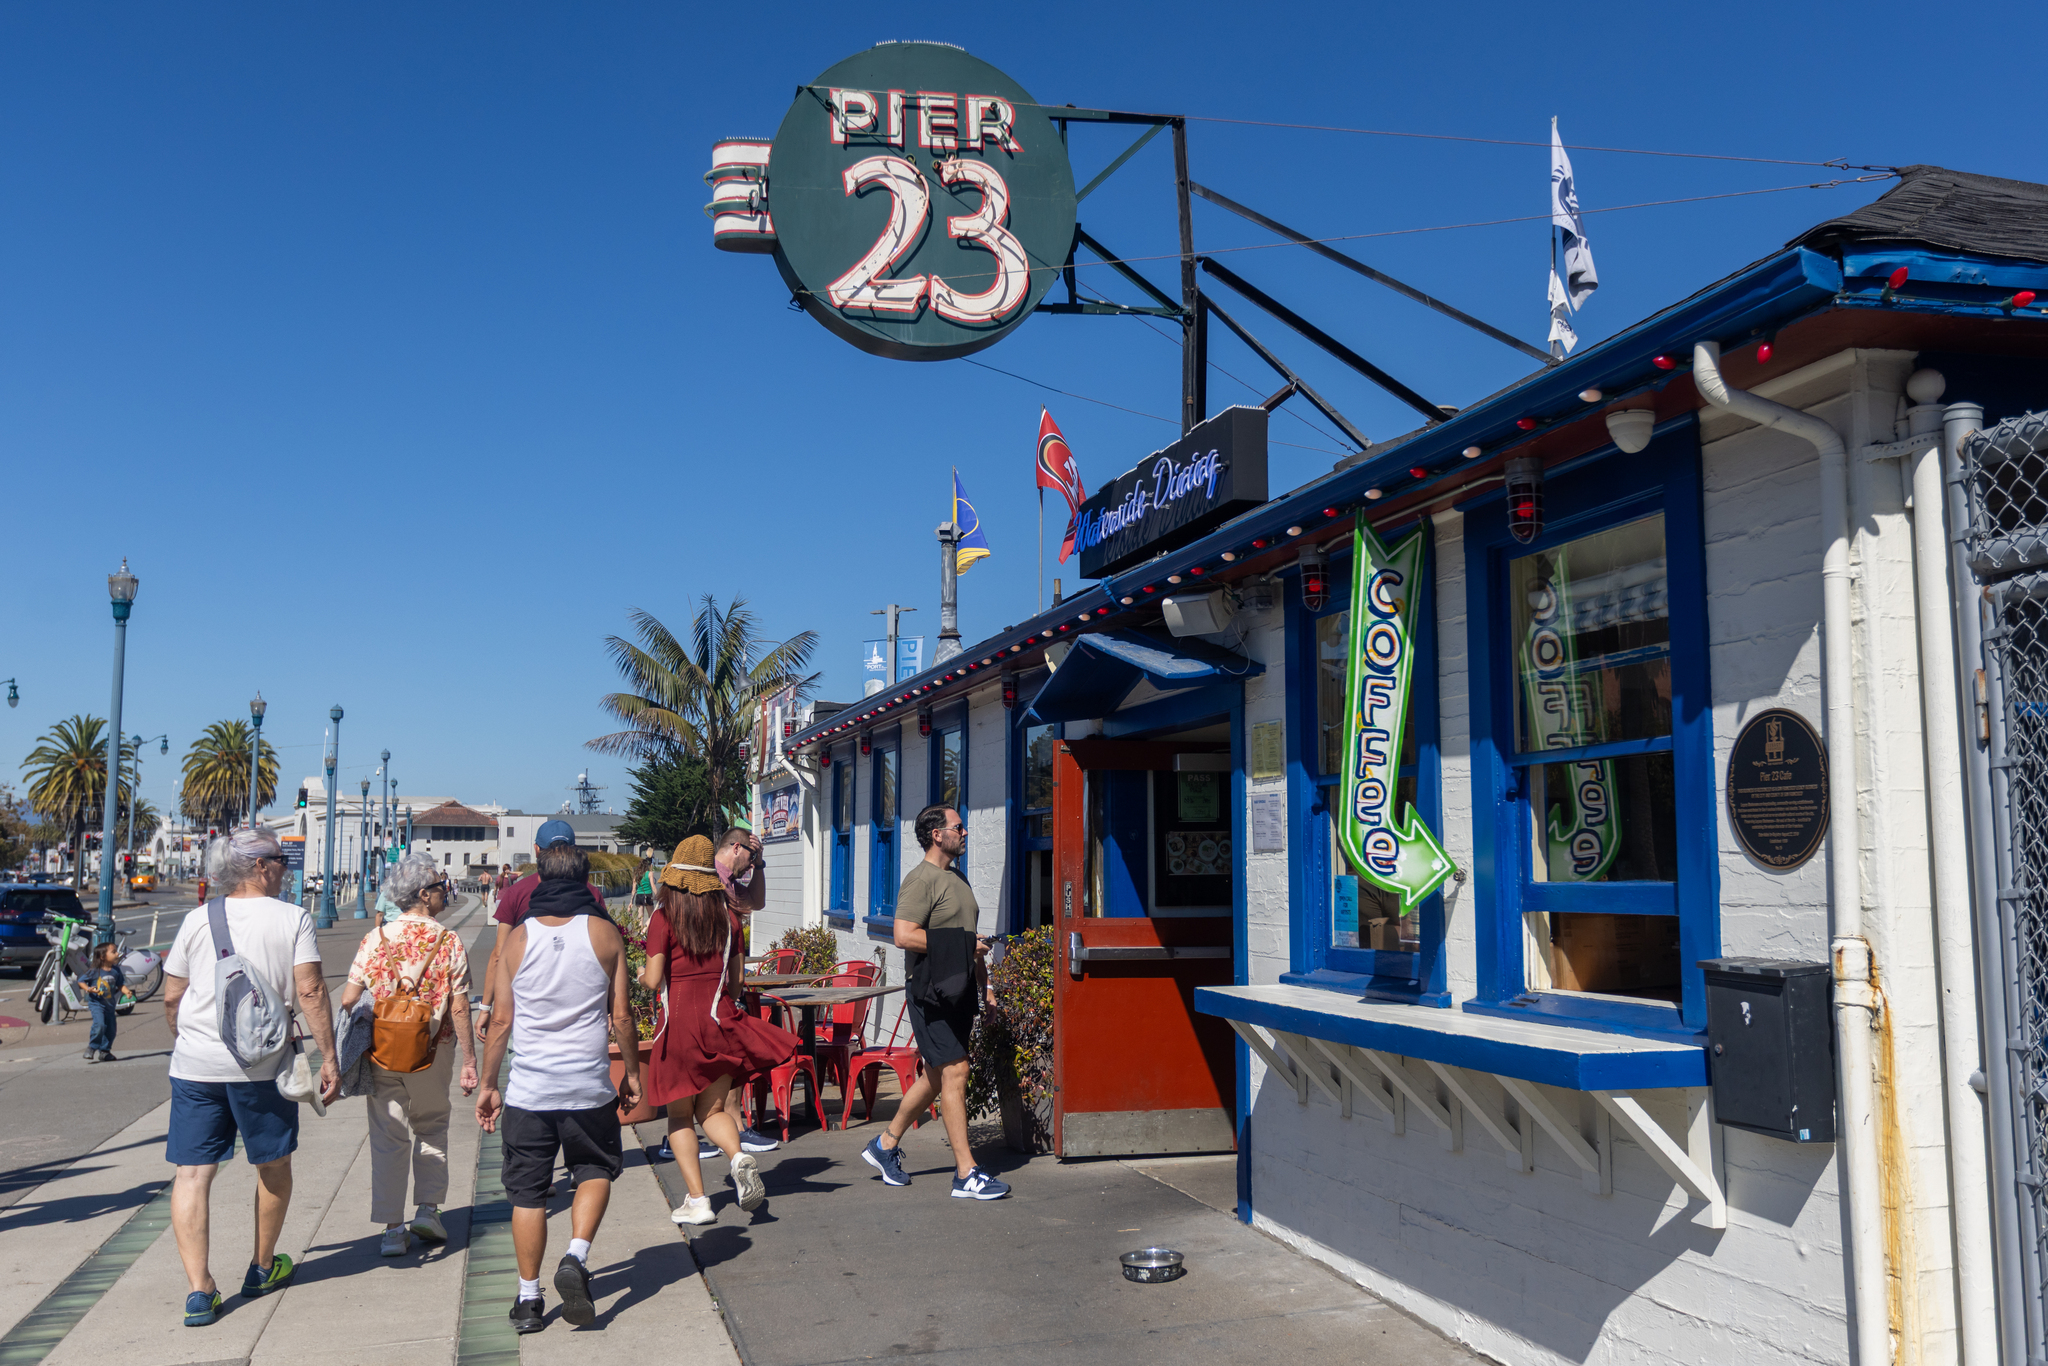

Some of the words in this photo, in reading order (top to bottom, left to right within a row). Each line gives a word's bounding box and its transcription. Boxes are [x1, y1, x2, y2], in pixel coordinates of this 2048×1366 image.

[829, 88, 1024, 152] PIER
[826, 155, 1029, 321] 23
[1152, 449, 1222, 511] Dining
[1187, 774, 1211, 782] PASS
